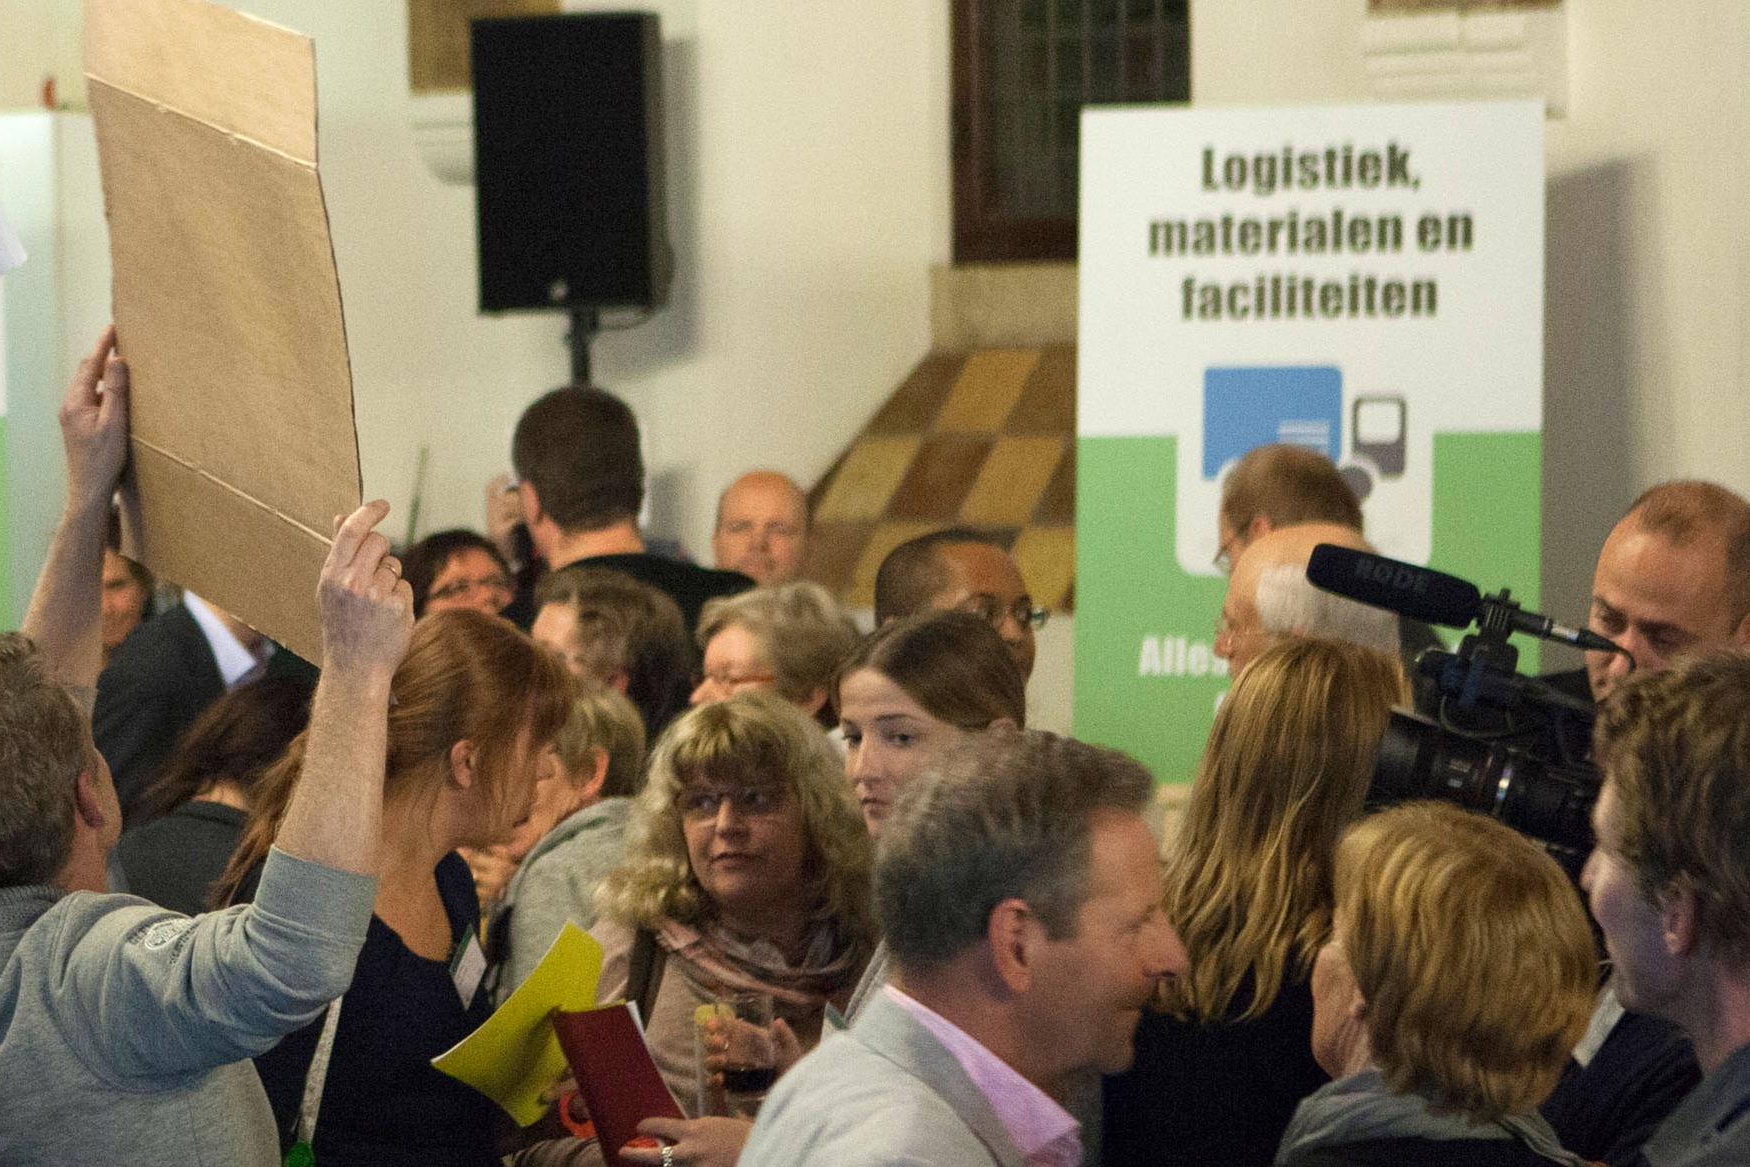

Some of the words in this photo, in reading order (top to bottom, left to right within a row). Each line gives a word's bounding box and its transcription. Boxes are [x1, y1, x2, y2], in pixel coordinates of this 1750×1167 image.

[1202, 142, 1420, 196] Logistiek,
[1148, 207, 1403, 255] materialen
[1416, 213, 1473, 252] en
[1182, 274, 1437, 319] faciliteiten
